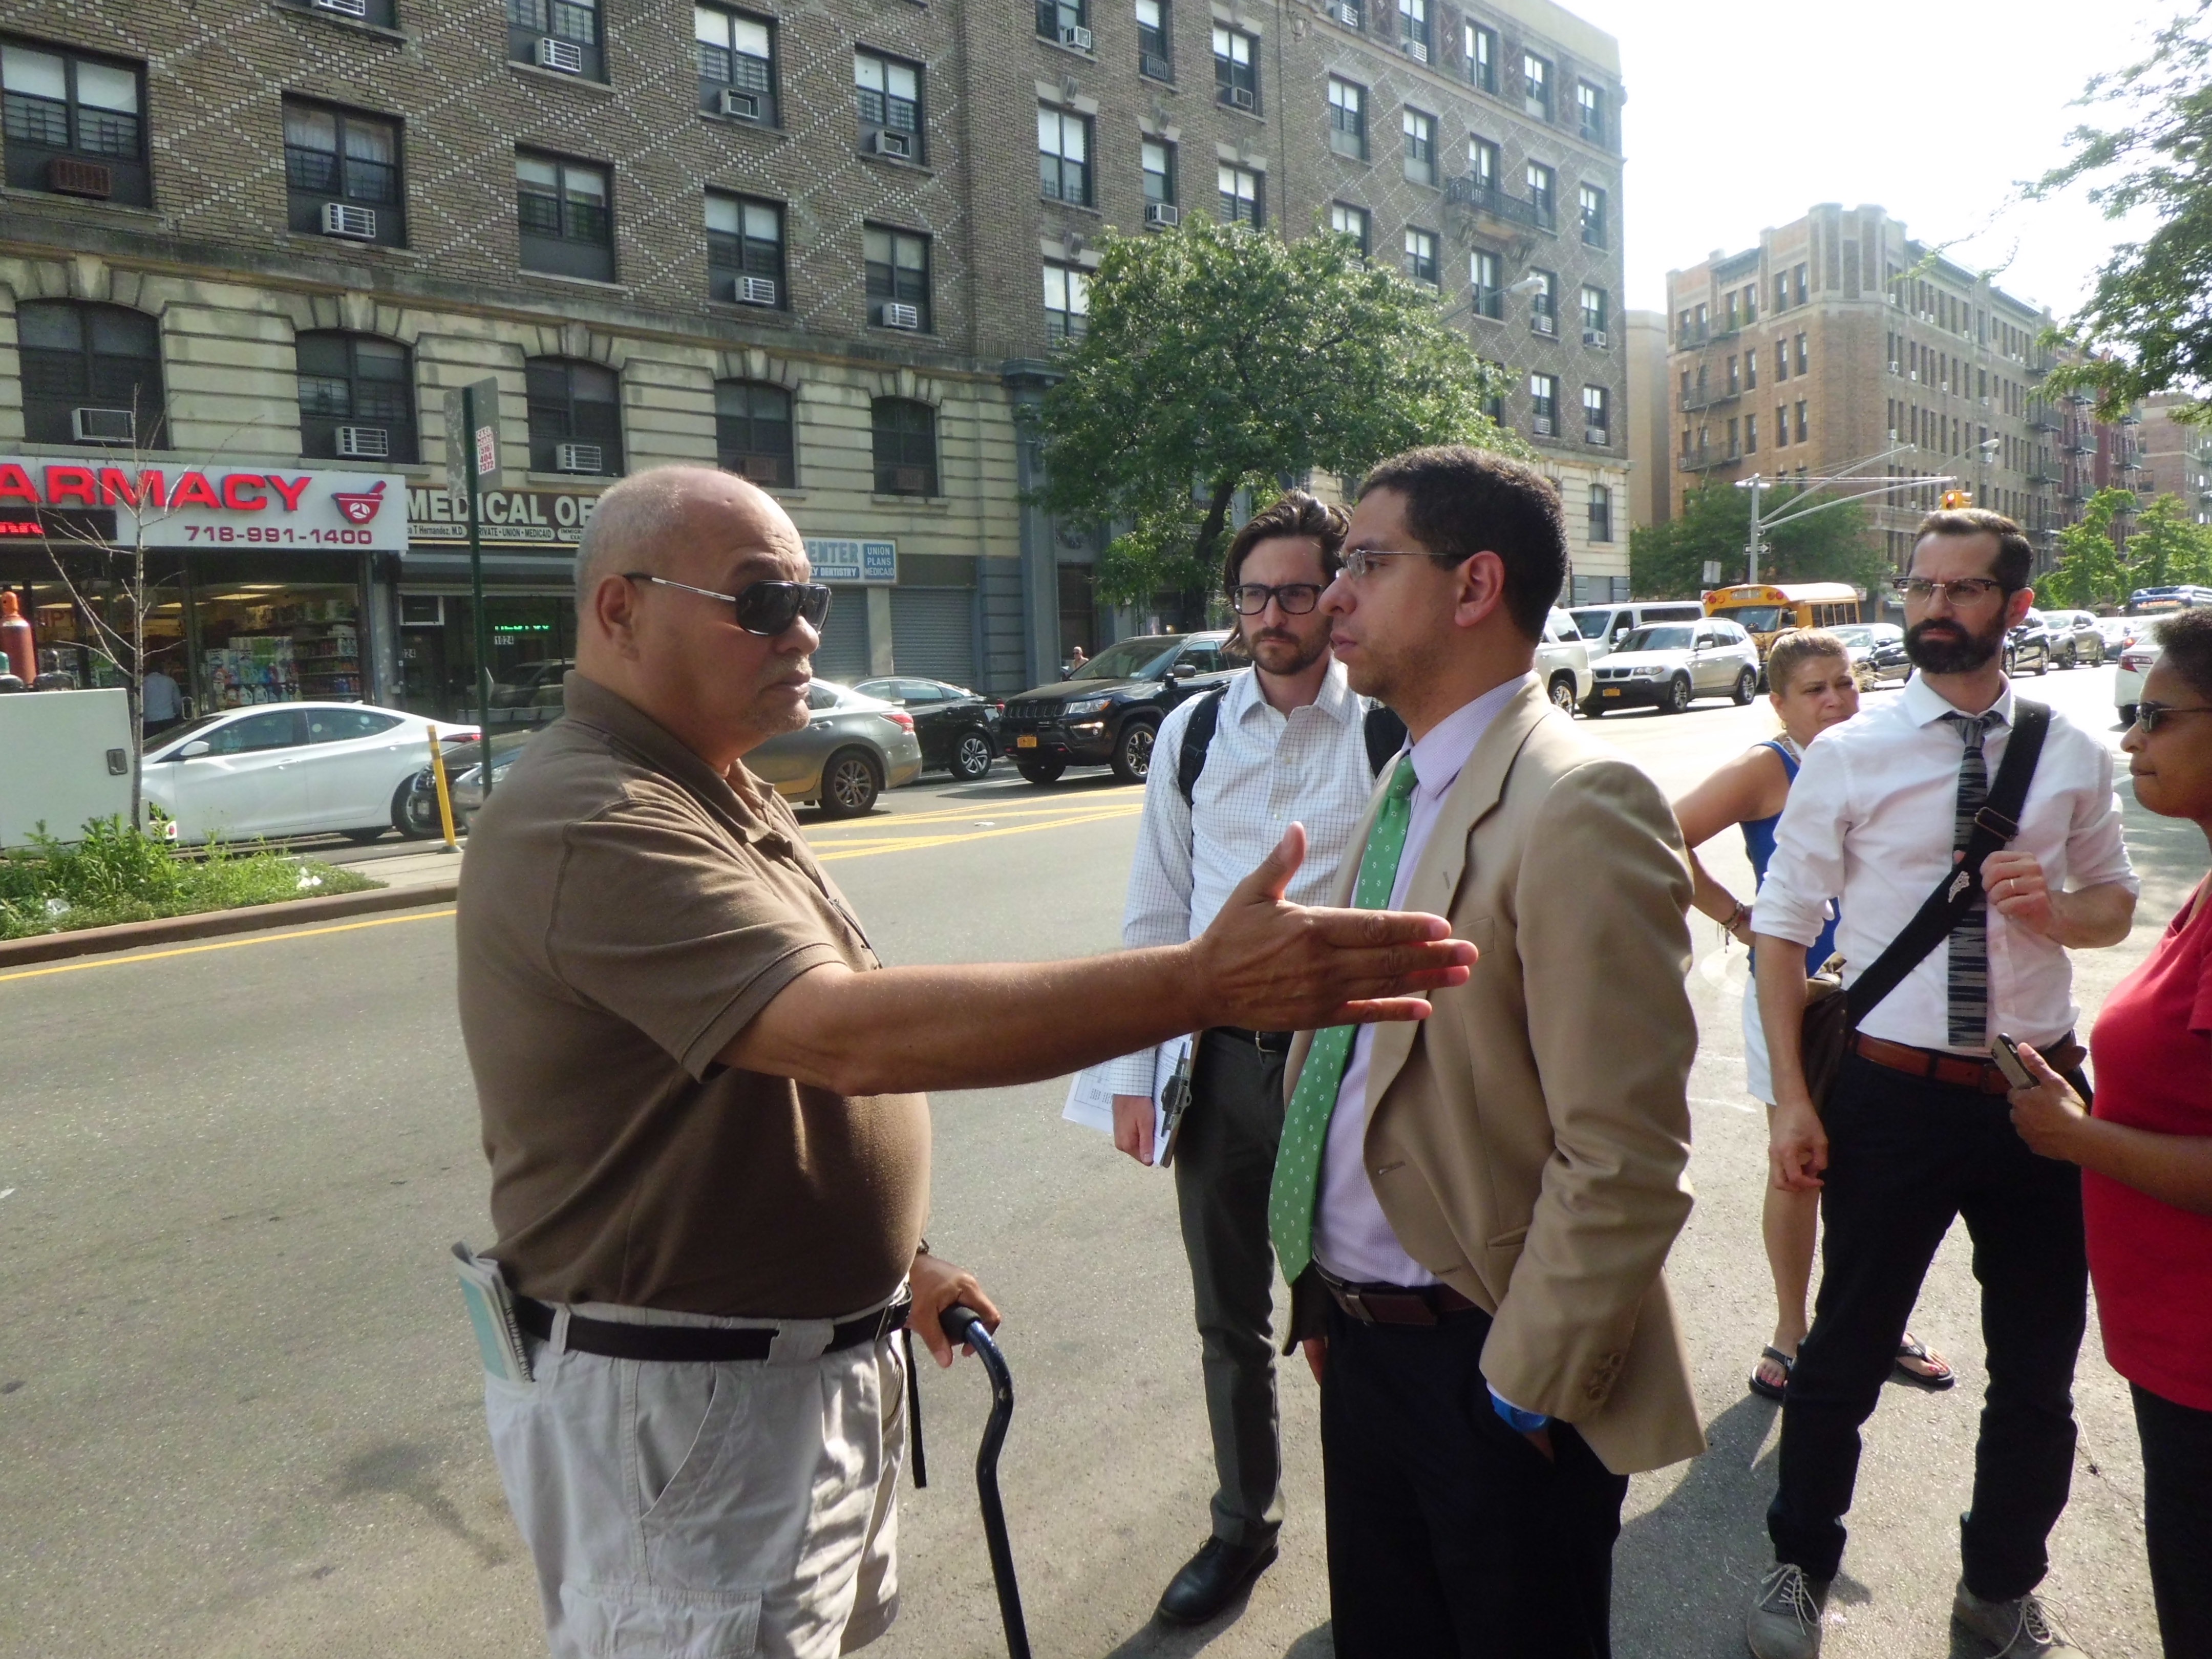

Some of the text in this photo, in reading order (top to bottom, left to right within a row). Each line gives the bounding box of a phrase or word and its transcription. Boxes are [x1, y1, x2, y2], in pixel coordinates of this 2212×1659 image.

[479, 460, 494, 473] 7372
[0, 463, 312, 512] ARMACY
[407, 488, 547, 524] MEDICAL
[413, 525, 417, 534] T
[478, 527, 551, 538] RIVATE UNION MEDICAID
[185, 526, 372, 544] 718-991-1400
[803, 540, 859, 563] ENTER
[867, 546, 890, 556] UNION
[867, 557, 891, 565] PLANS
[821, 567, 857, 576] DENTISTRY
[865, 567, 894, 576] MEDICAID
[494, 635, 514, 645] 1024
